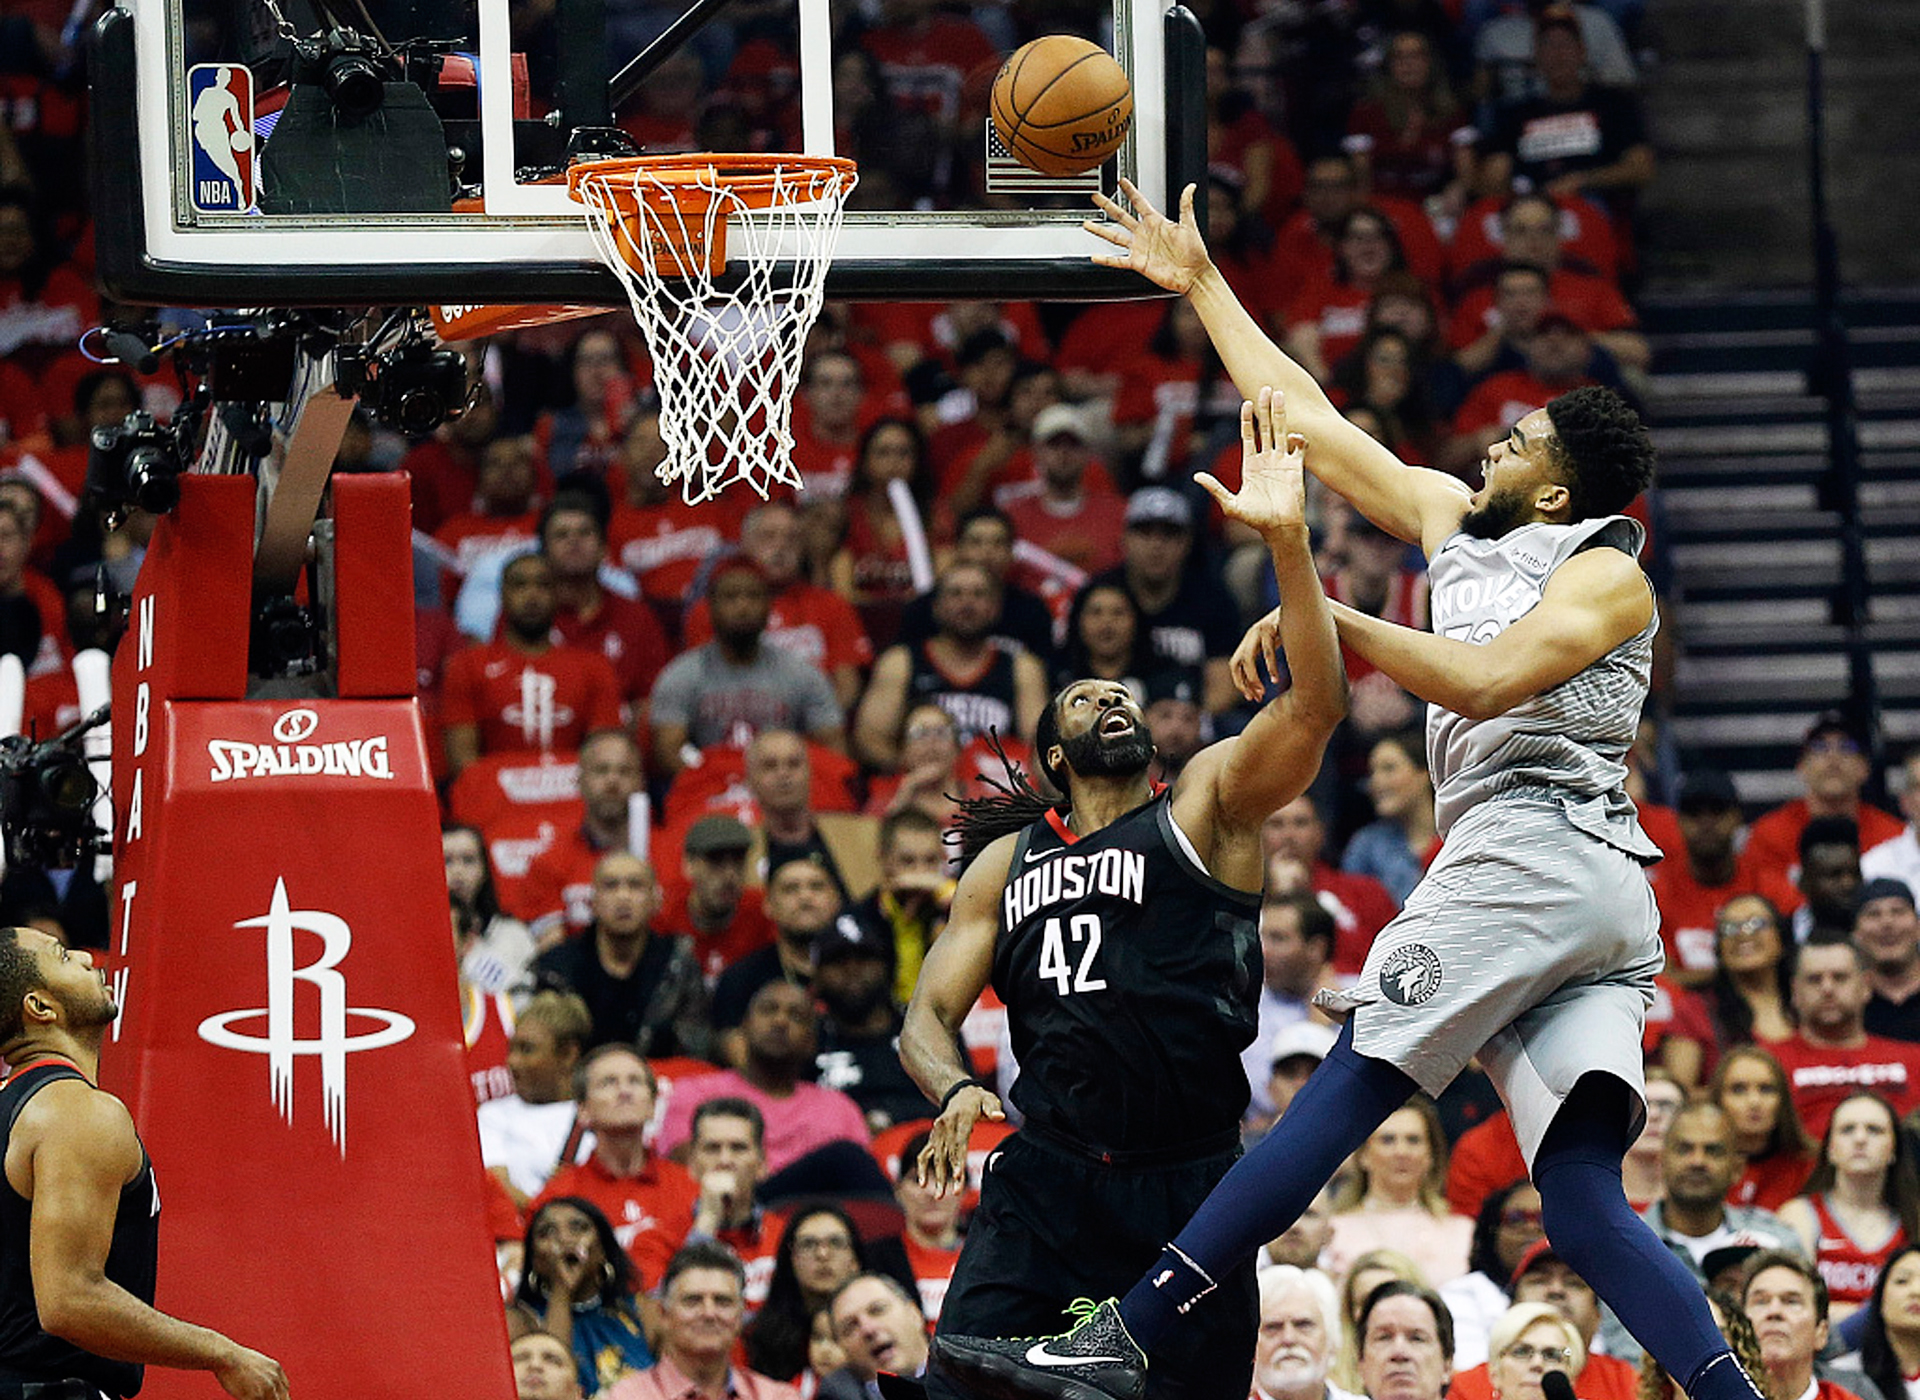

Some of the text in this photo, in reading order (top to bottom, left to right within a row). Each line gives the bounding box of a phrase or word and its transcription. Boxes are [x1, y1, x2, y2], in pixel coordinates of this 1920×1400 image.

[200, 181, 231, 204] NBA
[1004, 848, 1146, 933] HOUSTON
[1038, 914, 1108, 996] 42
